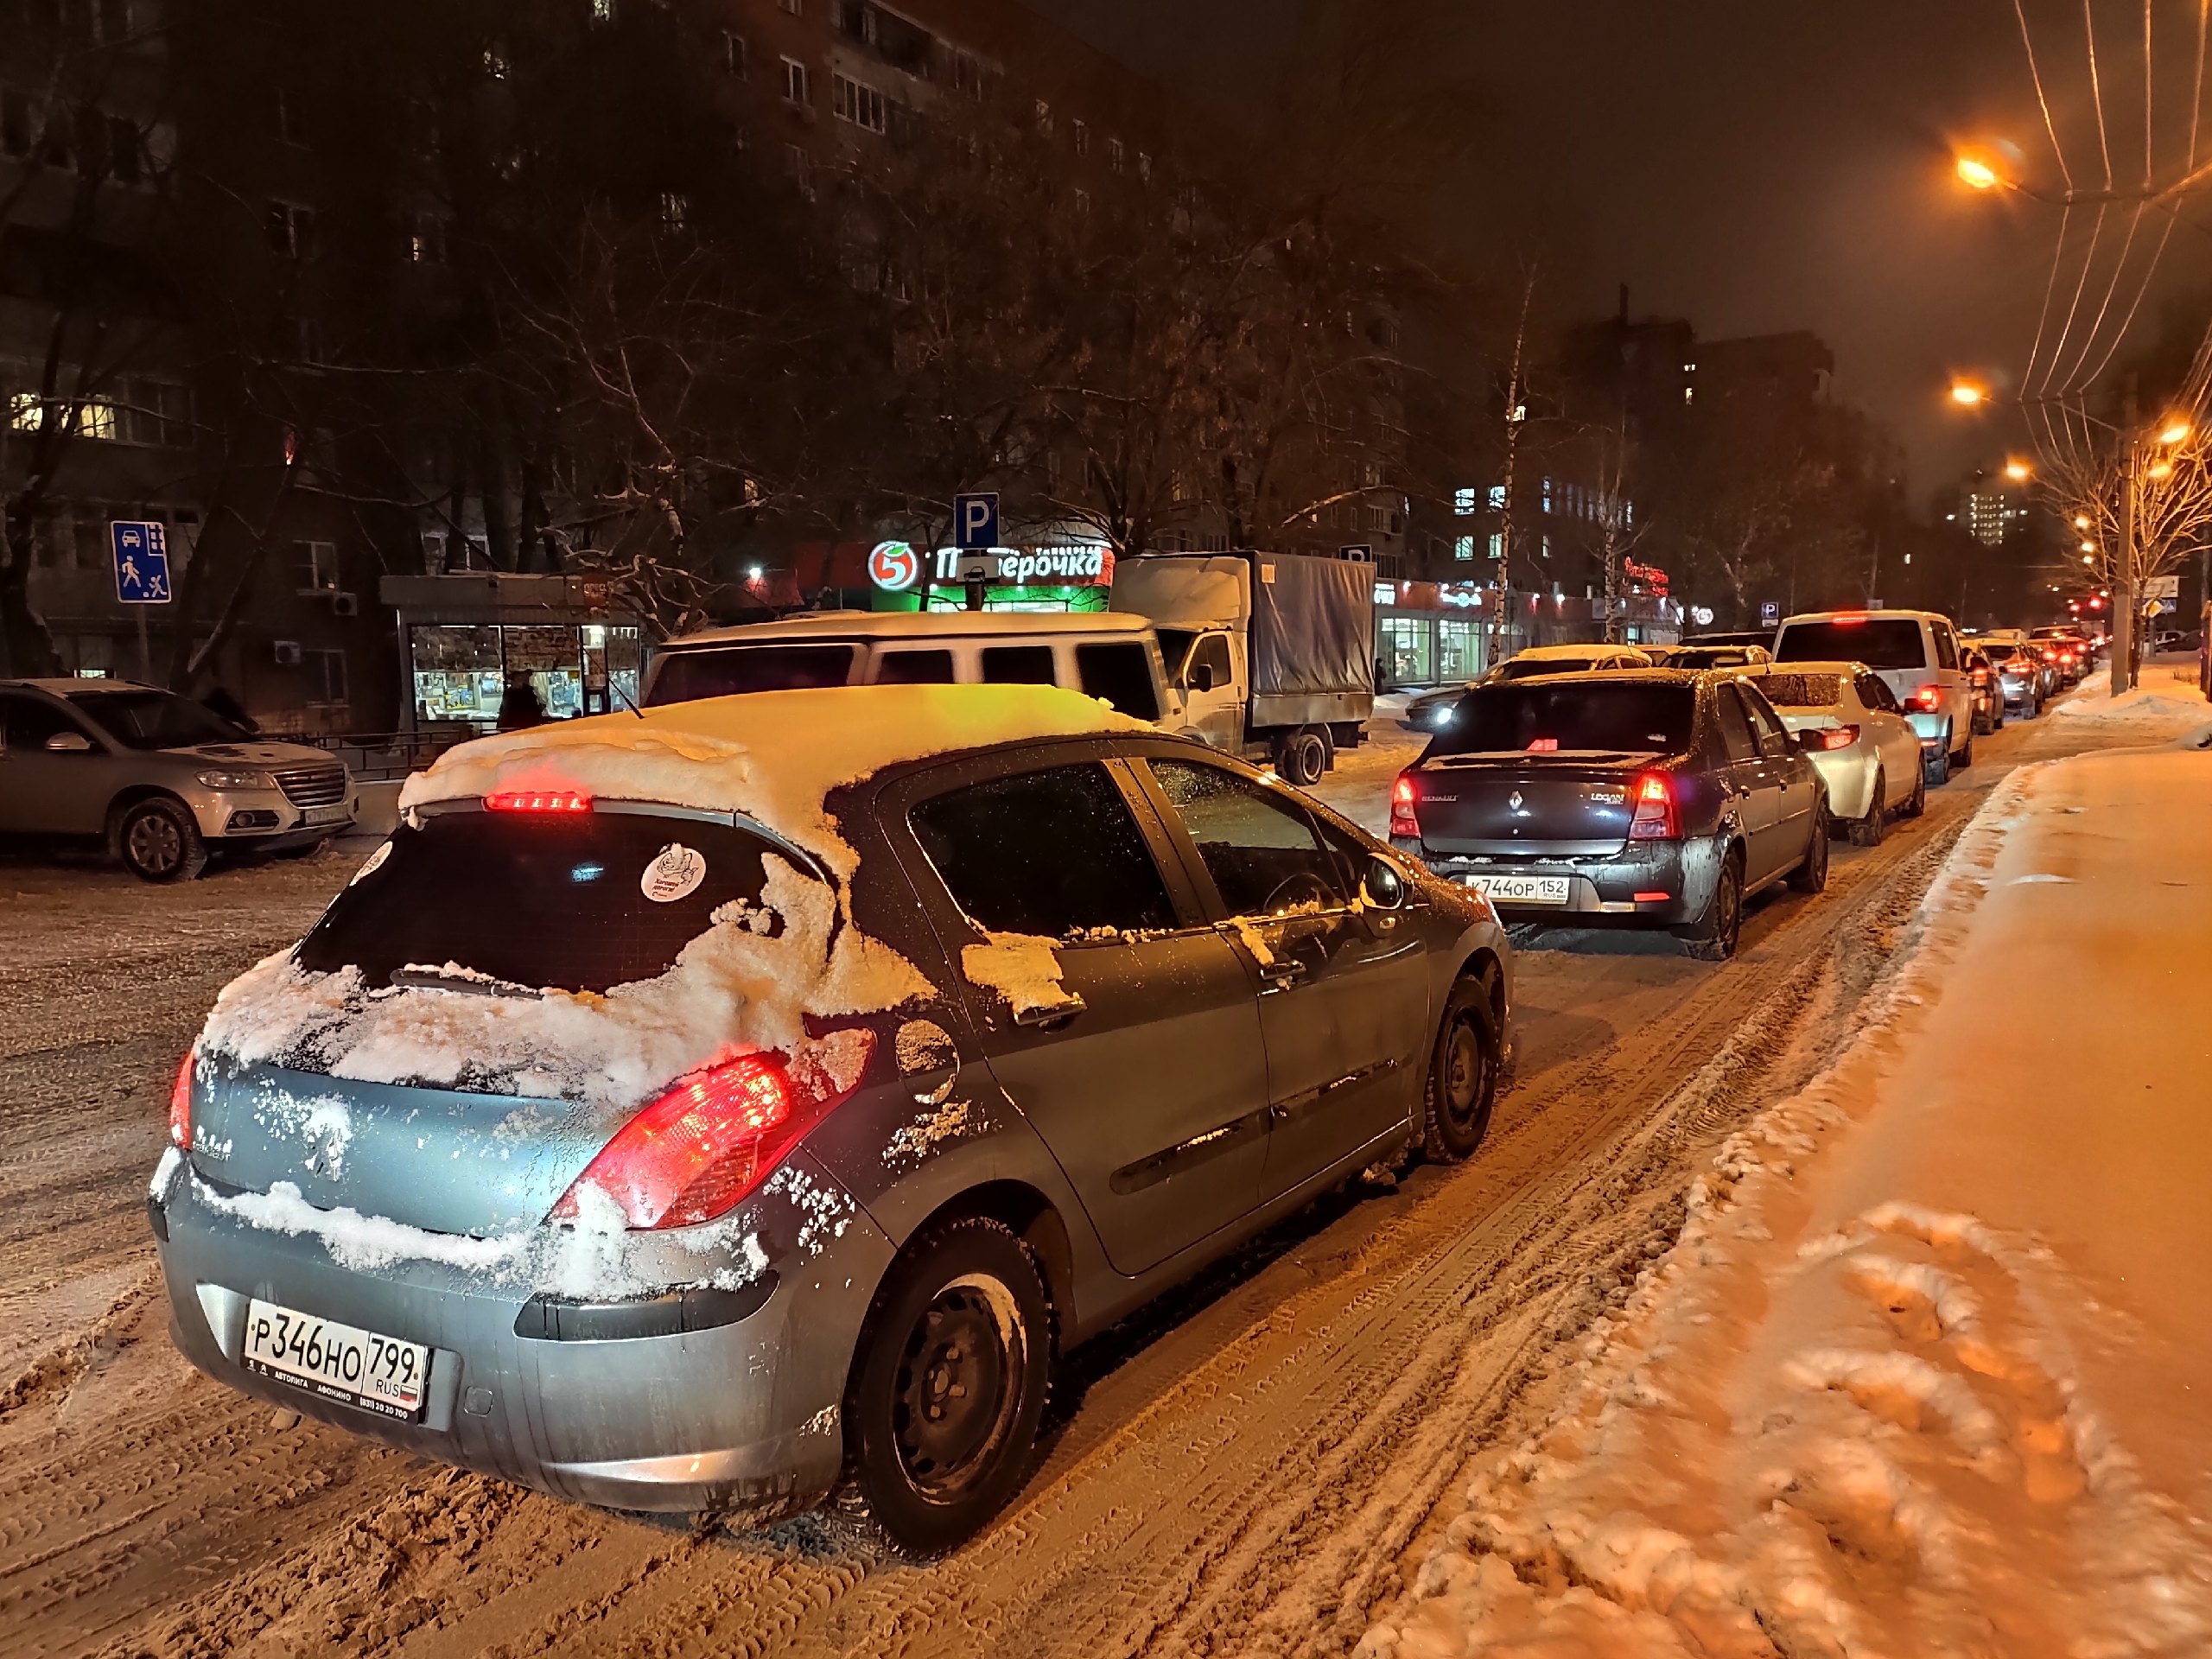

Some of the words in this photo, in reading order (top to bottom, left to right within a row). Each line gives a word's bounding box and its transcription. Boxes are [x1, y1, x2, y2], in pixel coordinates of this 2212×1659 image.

[965, 500, 990, 543] P
[937, 547, 1103, 584] Пёрочка
[1539, 880, 1564, 894] 152
[370, 1338, 415, 1383] 799
[274, 1370, 308, 1389] АВТОЛИГА
[317, 1385, 352, 1402] АФОНИНО
[385, 1405, 394, 1415] 20
[375, 1379, 399, 1397] RUS
